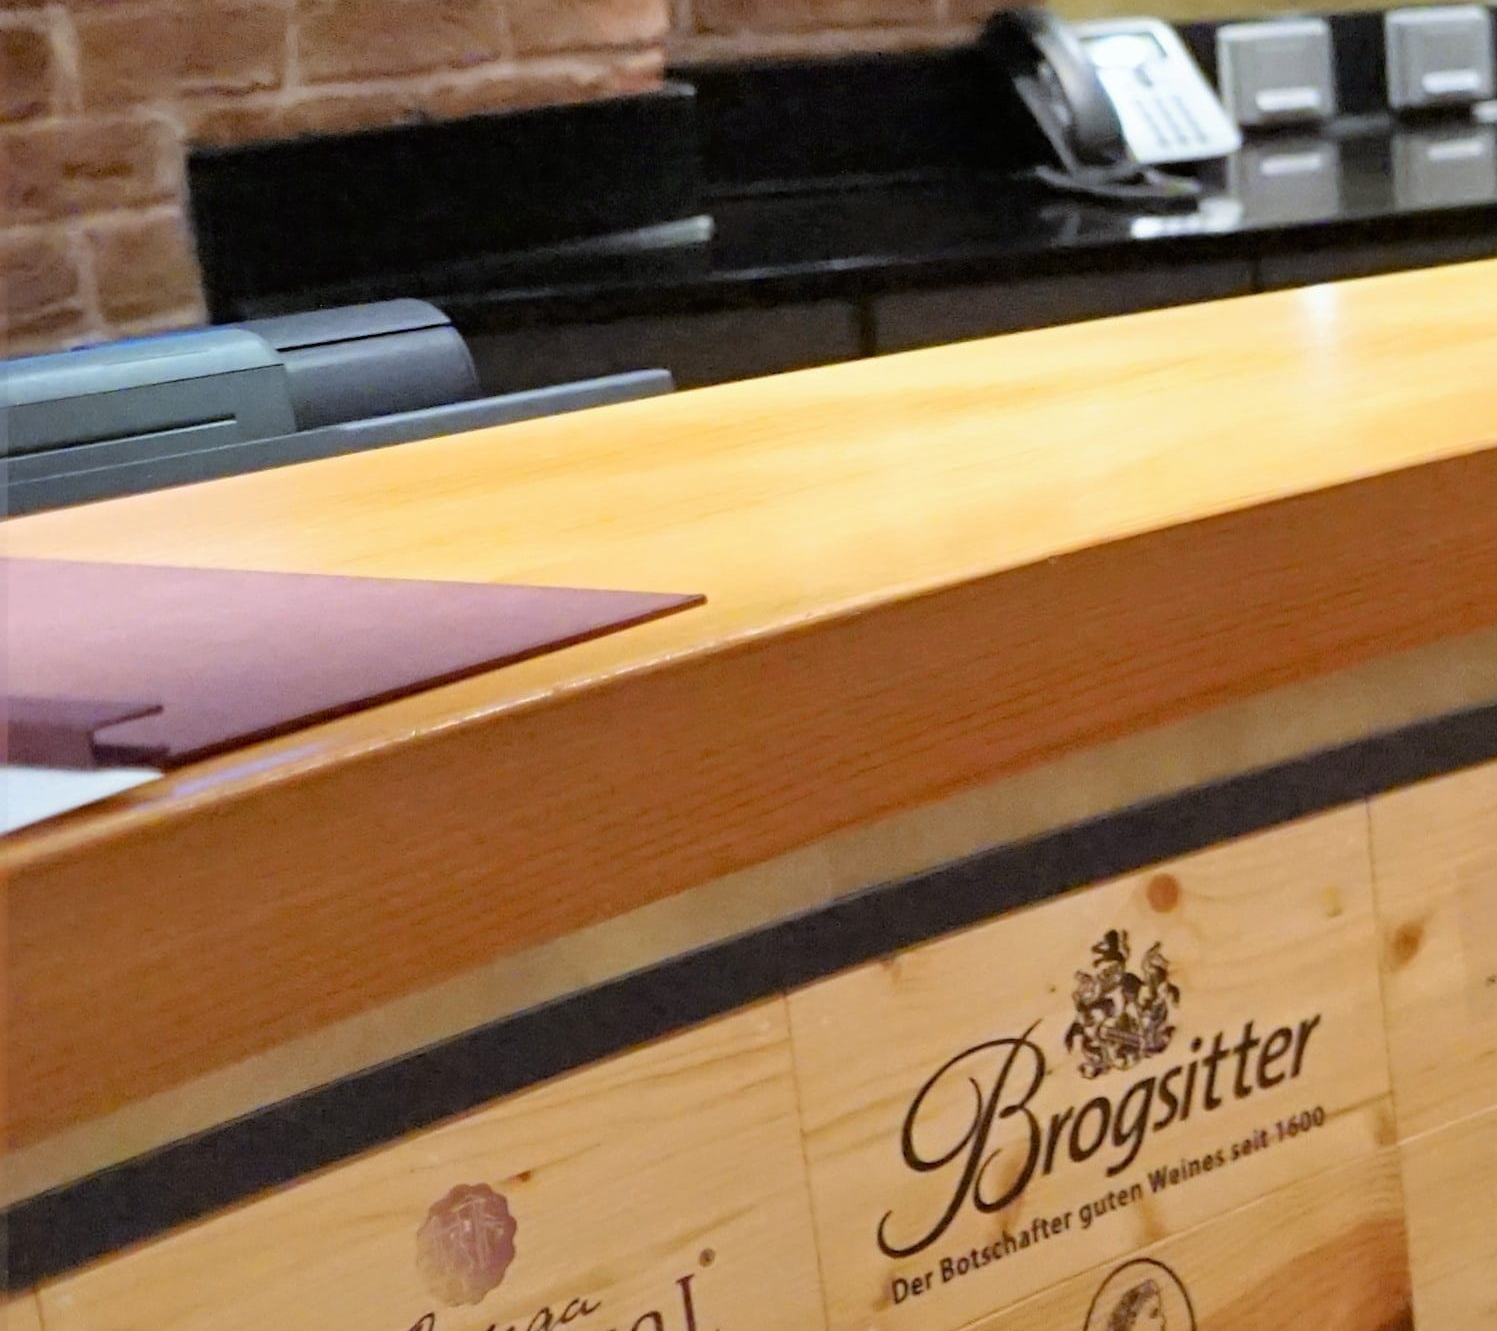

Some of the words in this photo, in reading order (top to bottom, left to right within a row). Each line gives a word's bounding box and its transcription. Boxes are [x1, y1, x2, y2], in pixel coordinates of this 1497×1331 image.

[876, 1012, 1324, 1259] Brogsitter
[889, 1272, 934, 1307] Der
[939, 1208, 1073, 1285] Botschafter
[1078, 1181, 1144, 1231] guten
[1148, 1146, 1226, 1196] Weines
[1229, 1129, 1271, 1166] seit
[1275, 1105, 1327, 1144] 1600
